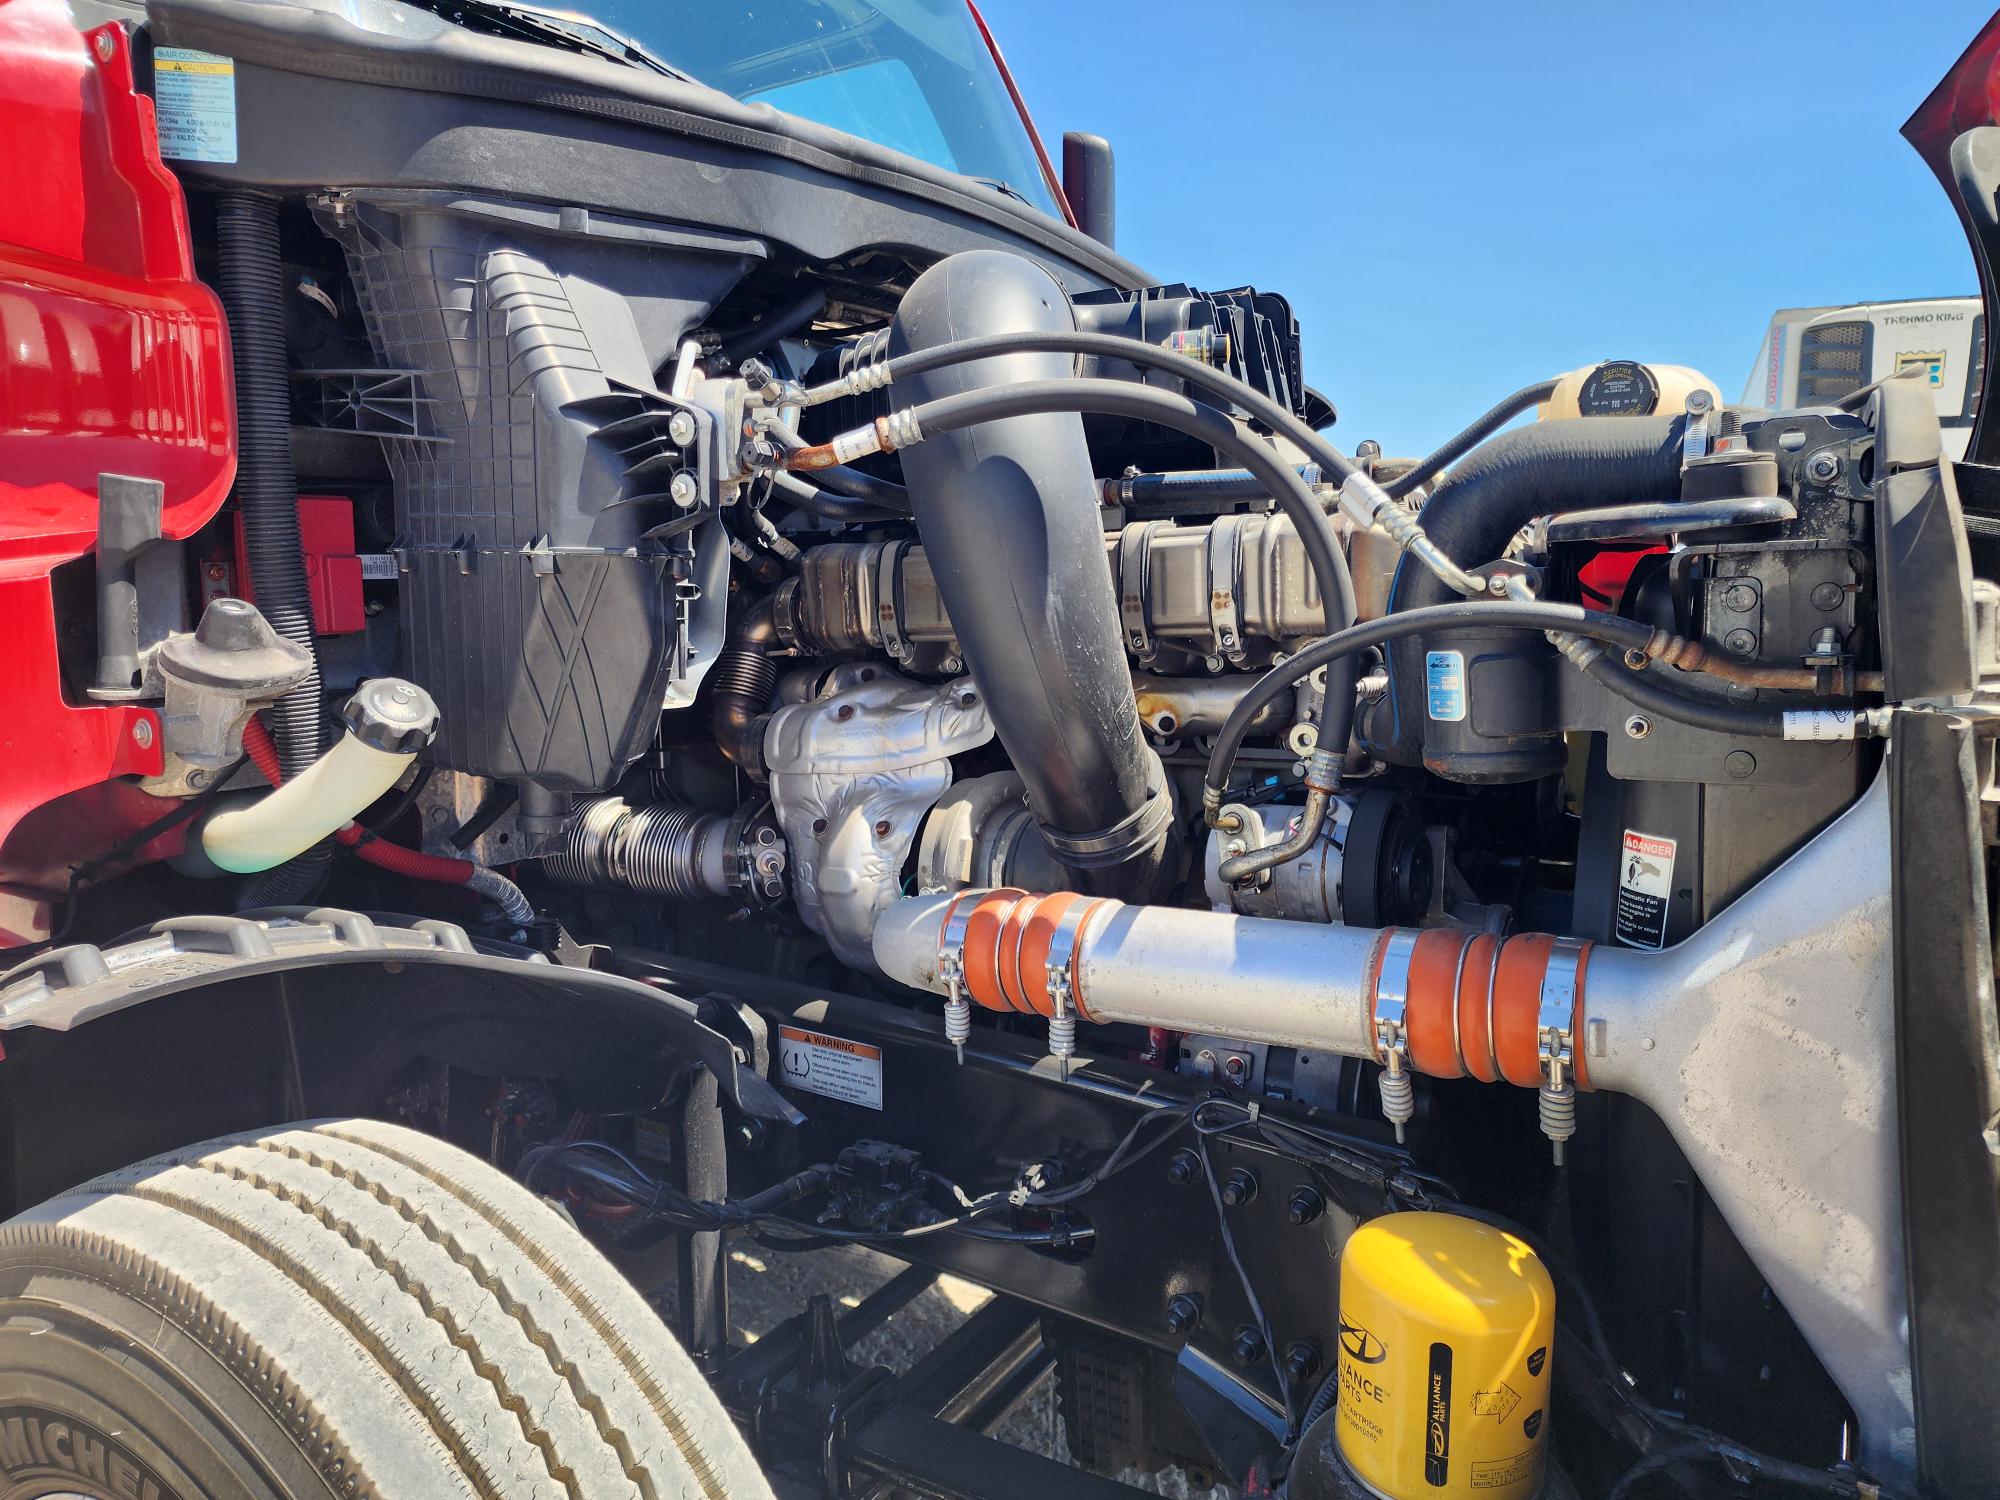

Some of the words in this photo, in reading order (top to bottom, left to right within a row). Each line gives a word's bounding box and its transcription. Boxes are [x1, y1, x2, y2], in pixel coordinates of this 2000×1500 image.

[164, 50, 178, 58] AIR
[182, 62, 216, 73] CAUTION
[1632, 839, 1672, 857] DANGER
[1646, 897, 1658, 905] Fan
[814, 1035, 855, 1053] WARNING
[1340, 1350, 1383, 1404] LIANCE
[1432, 1374, 1442, 1421] ALLIANCE
